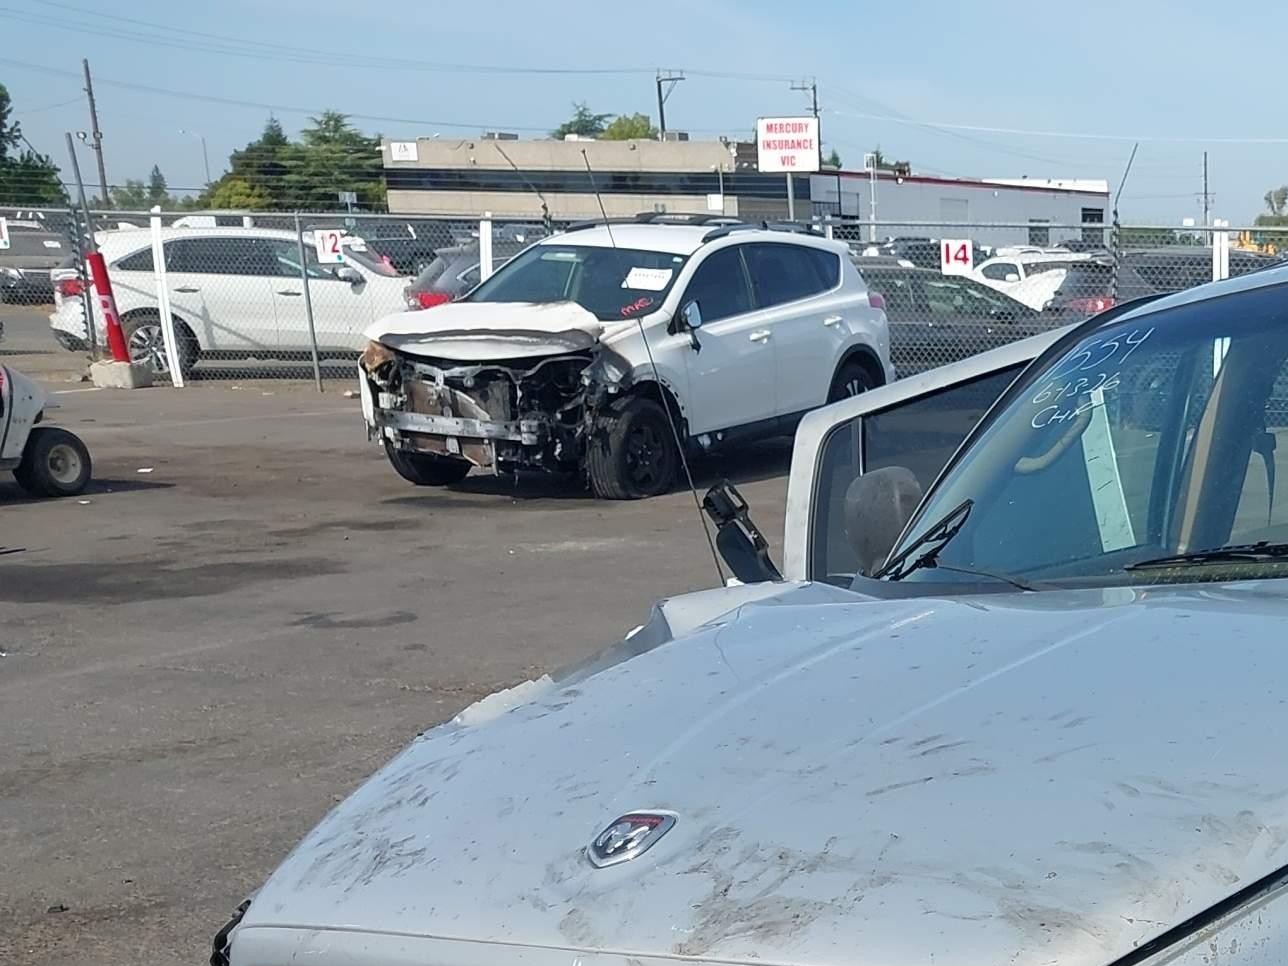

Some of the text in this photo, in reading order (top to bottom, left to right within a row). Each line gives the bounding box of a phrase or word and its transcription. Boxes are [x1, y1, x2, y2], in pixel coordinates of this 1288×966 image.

[766, 122, 809, 134] MERCURY
[762, 139, 814, 150] INSURANCE
[780, 155, 796, 167] VIC
[320, 233, 340, 253] 12
[945, 243, 969, 265] 14
